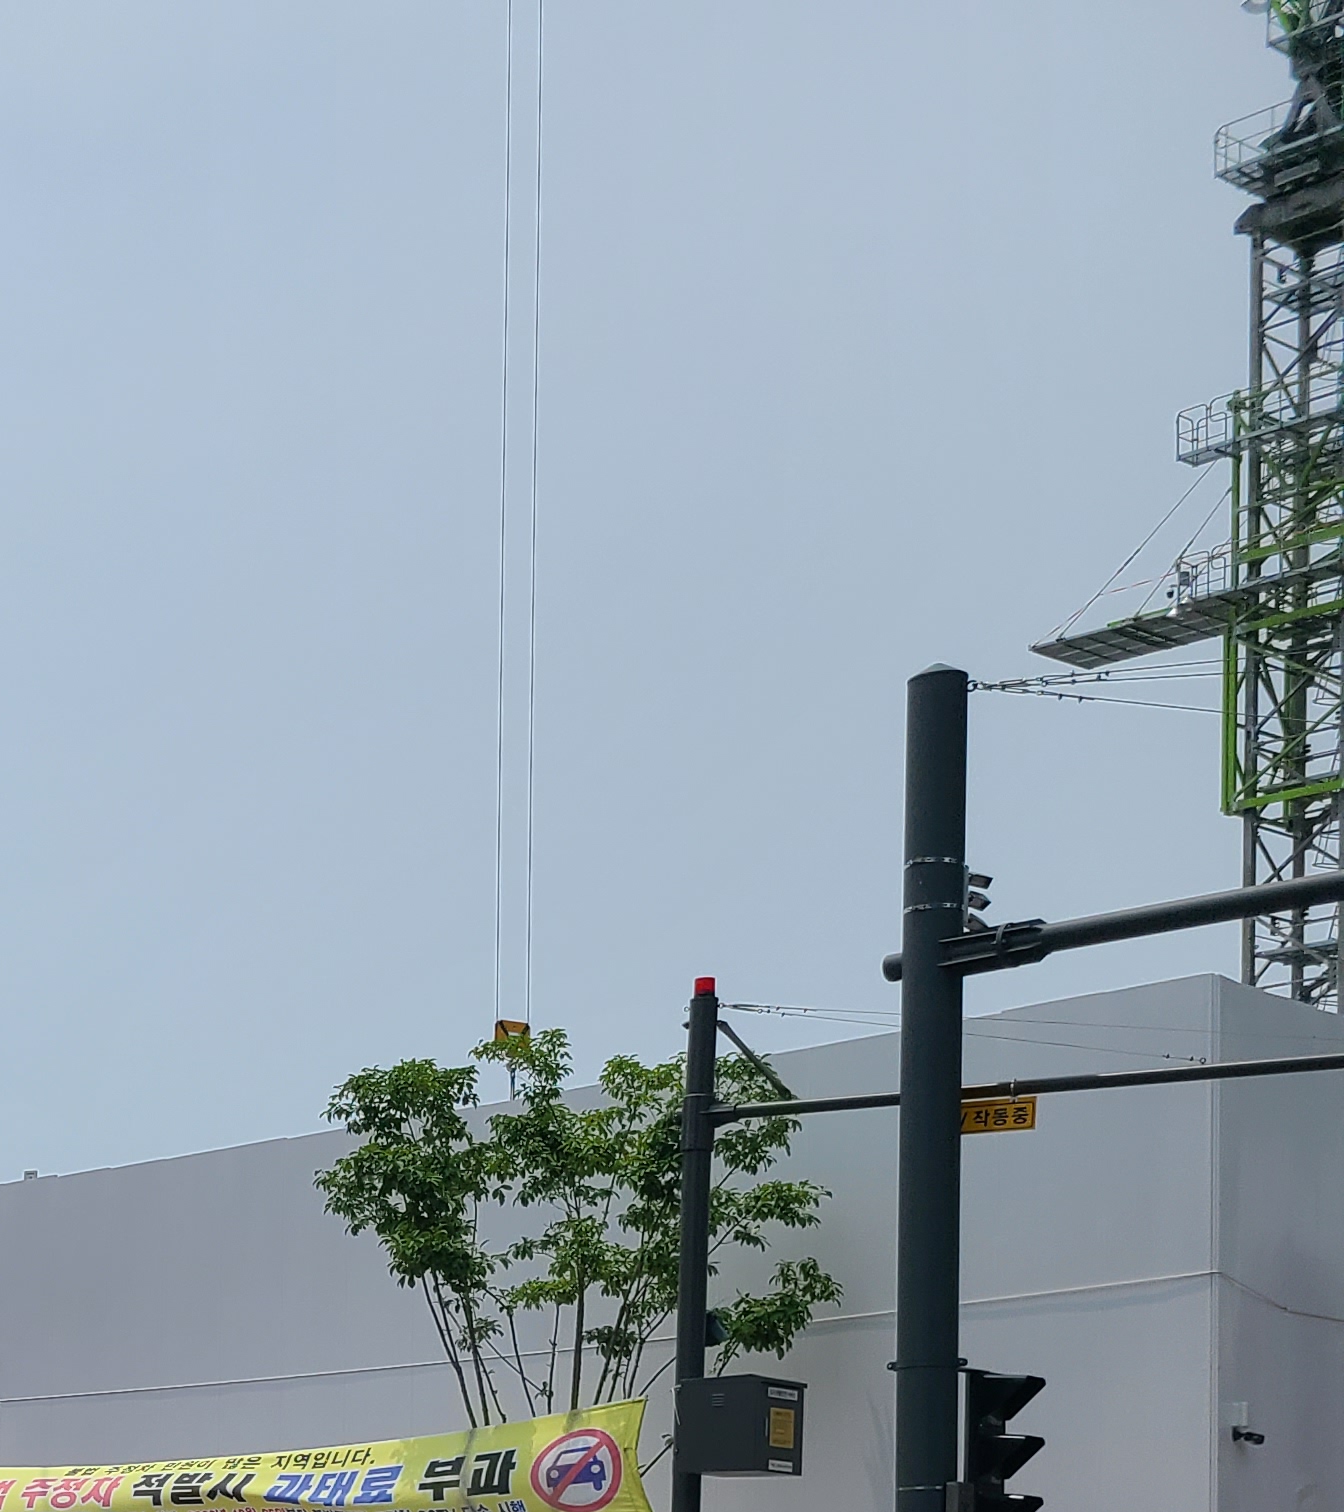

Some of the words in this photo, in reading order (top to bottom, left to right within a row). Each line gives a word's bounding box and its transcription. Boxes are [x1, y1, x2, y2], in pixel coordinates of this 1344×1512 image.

[973, 1107, 1029, 1127] 작동중
[222, 1456, 262, 1470] 많은
[271, 1447, 376, 1471] 지역입니다.
[21, 1475, 122, 1510] 주정차
[133, 1471, 256, 1507] 적발시
[418, 1448, 518, 1501] 부과
